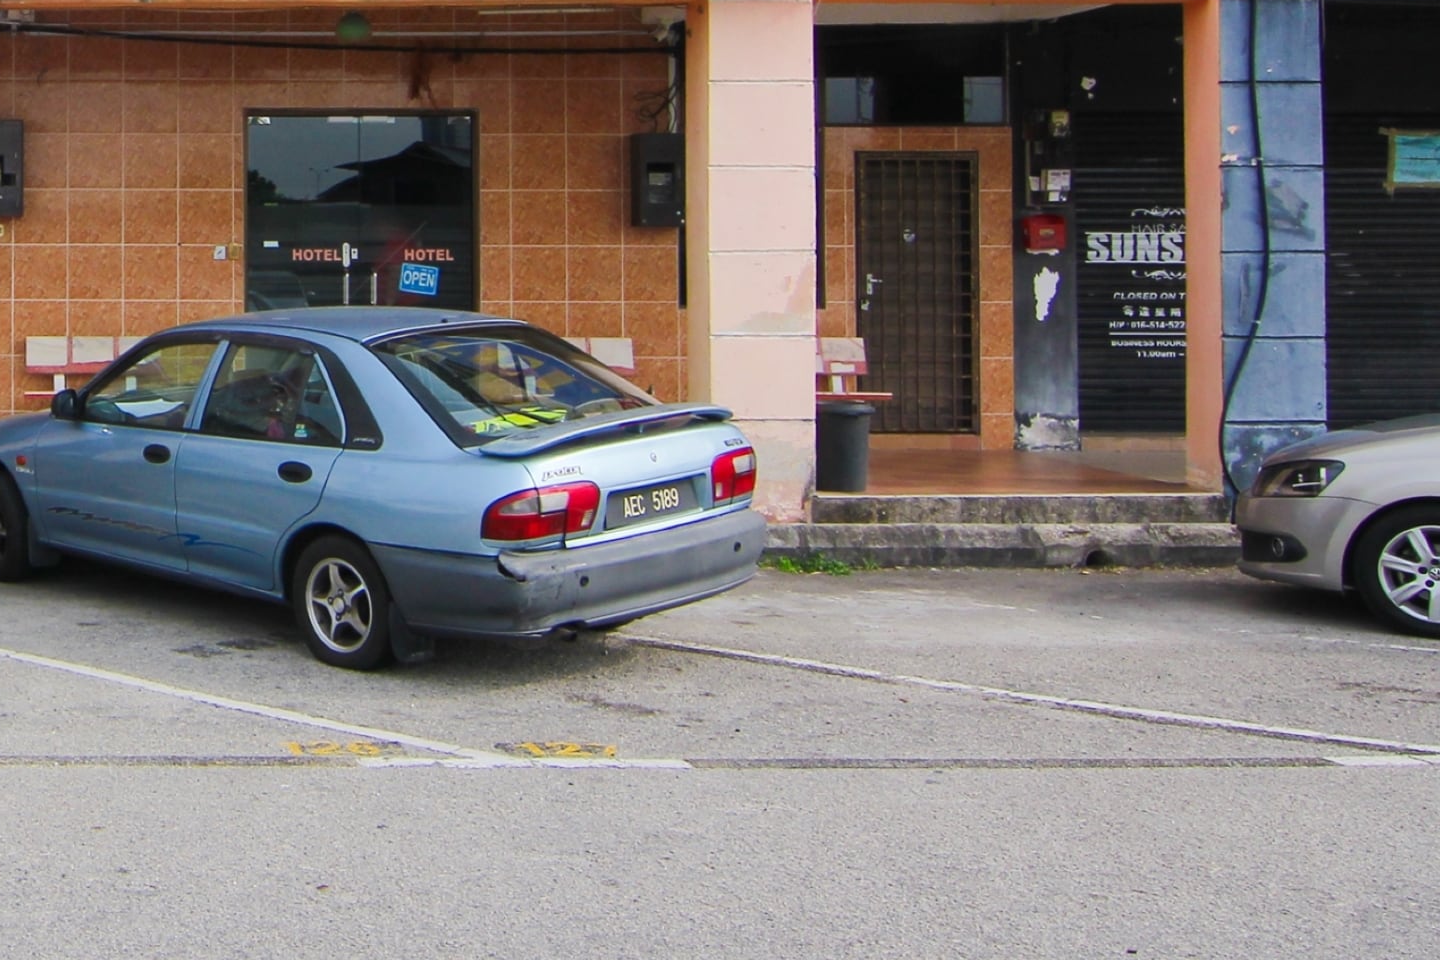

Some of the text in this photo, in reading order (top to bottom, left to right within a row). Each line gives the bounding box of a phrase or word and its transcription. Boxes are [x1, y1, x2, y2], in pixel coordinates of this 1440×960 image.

[1131, 224, 1164, 234] HAIR
[292, 248, 342, 261] HOTEL
[404, 249, 455, 261] HOTEL
[403, 270, 435, 288] OPEN
[1113, 292, 1158, 300] CLOSED
[1160, 292, 1176, 300] ON
[623, 487, 680, 518] AEC 5189
